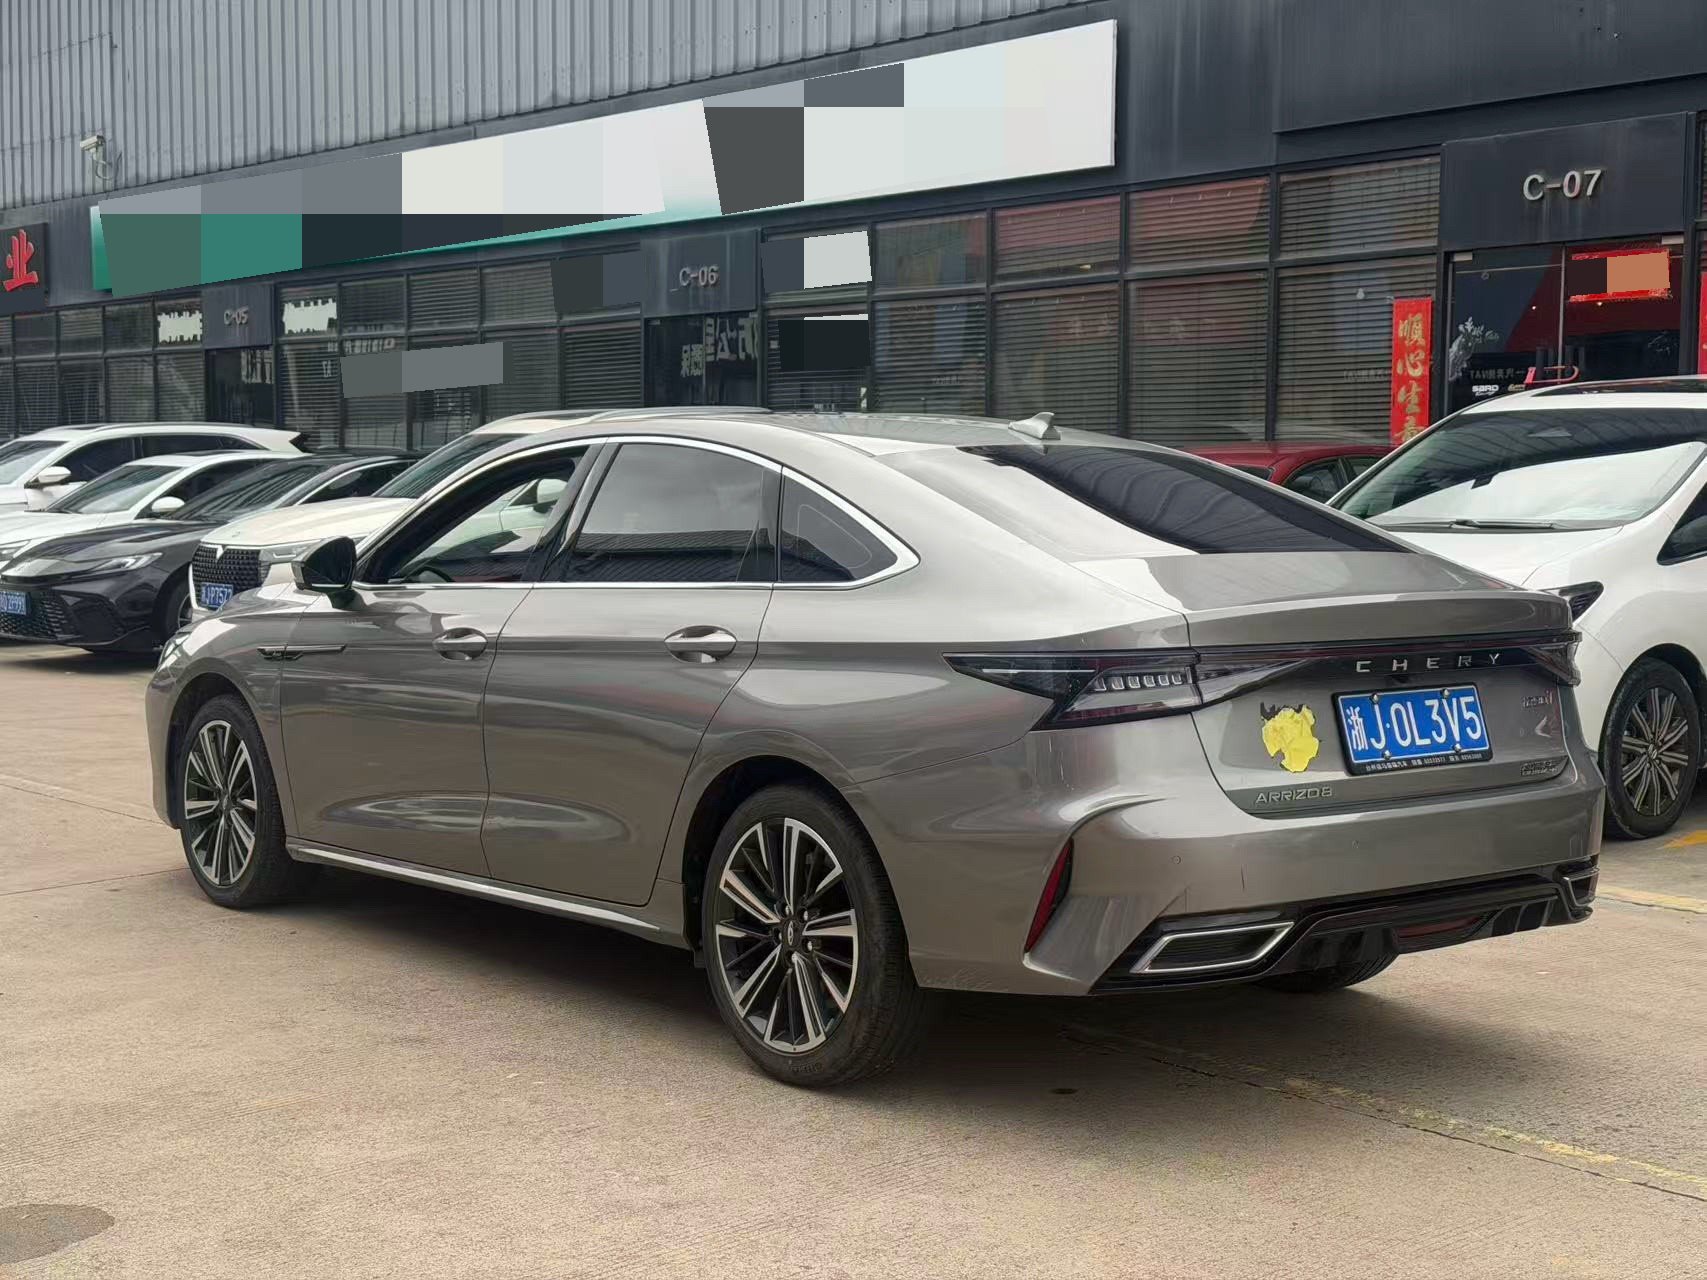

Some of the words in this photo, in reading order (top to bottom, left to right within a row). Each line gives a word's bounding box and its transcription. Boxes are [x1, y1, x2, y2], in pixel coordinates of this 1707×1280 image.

[1523, 169, 1603, 200] C-07
[3, 229, 39, 292] 业
[679, 265, 719, 286] C-06
[223, 307, 249, 325] C-05
[1356, 653, 1500, 673] CHERY
